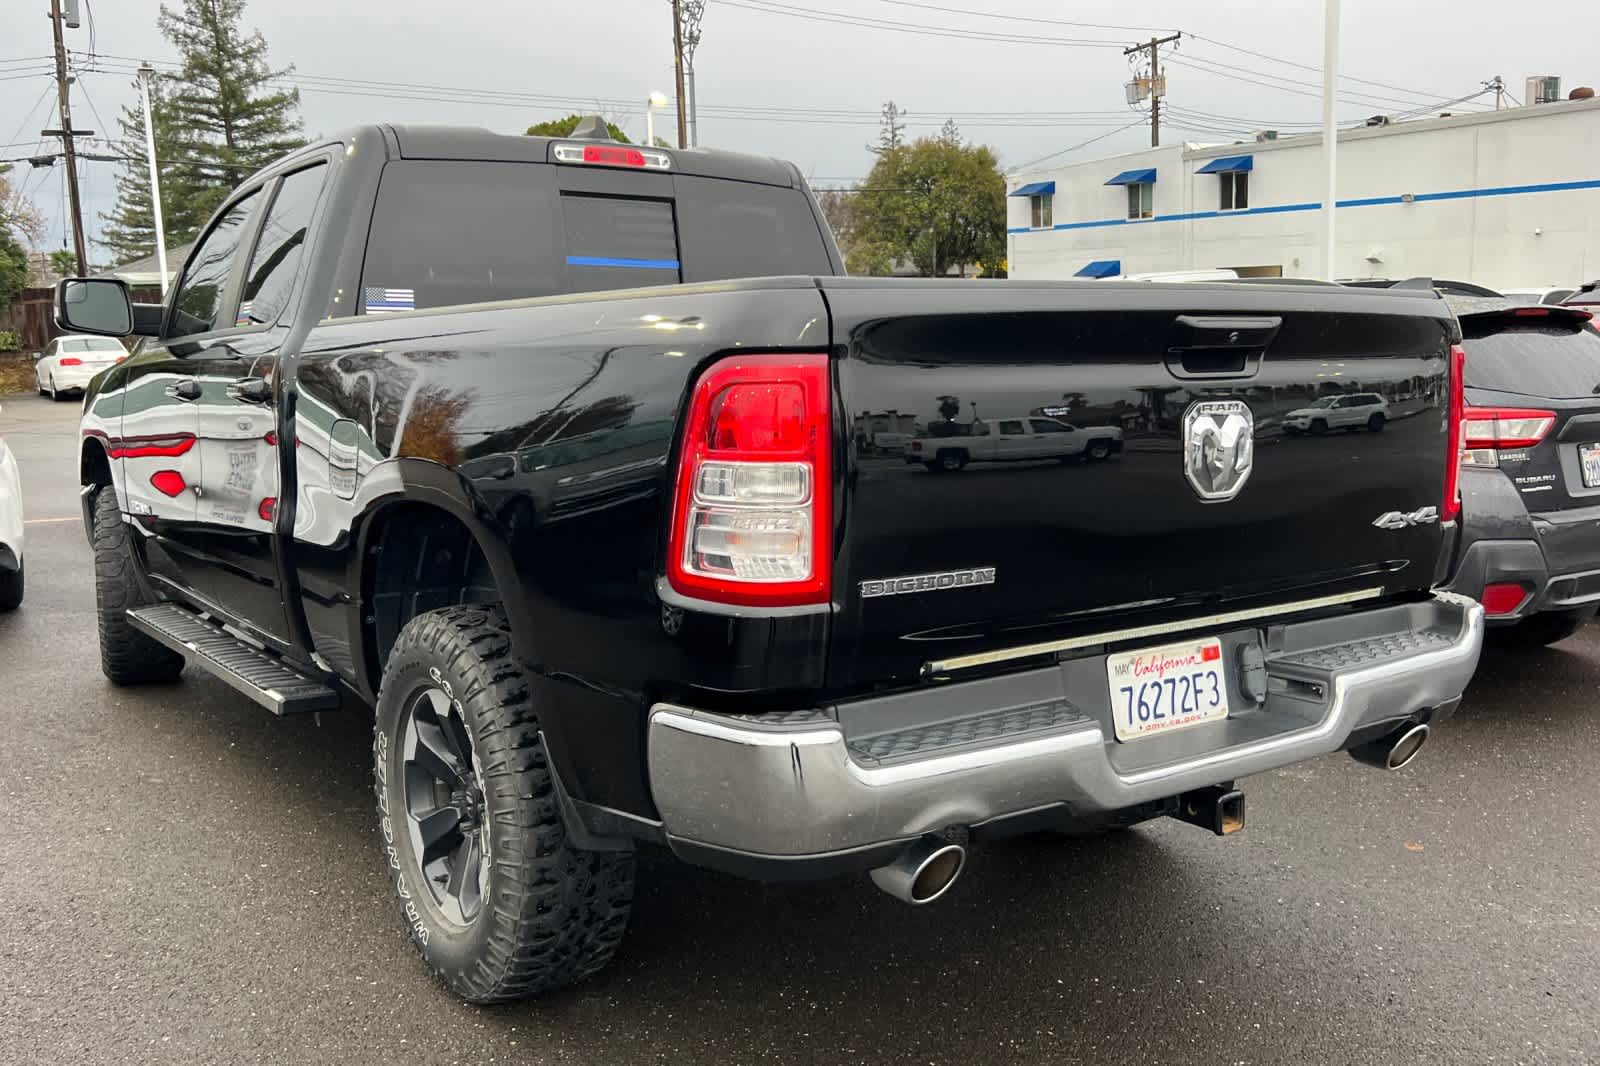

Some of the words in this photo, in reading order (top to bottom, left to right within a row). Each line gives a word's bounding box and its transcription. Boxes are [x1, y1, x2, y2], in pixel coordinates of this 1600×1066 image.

[1201, 403, 1240, 412] RAM
[862, 568, 996, 598] BIGHORN
[1114, 663, 1131, 677] MAY
[1134, 654, 1203, 678] California
[1120, 671, 1220, 725] 76272F3
[379, 731, 428, 946] WRANGLER
